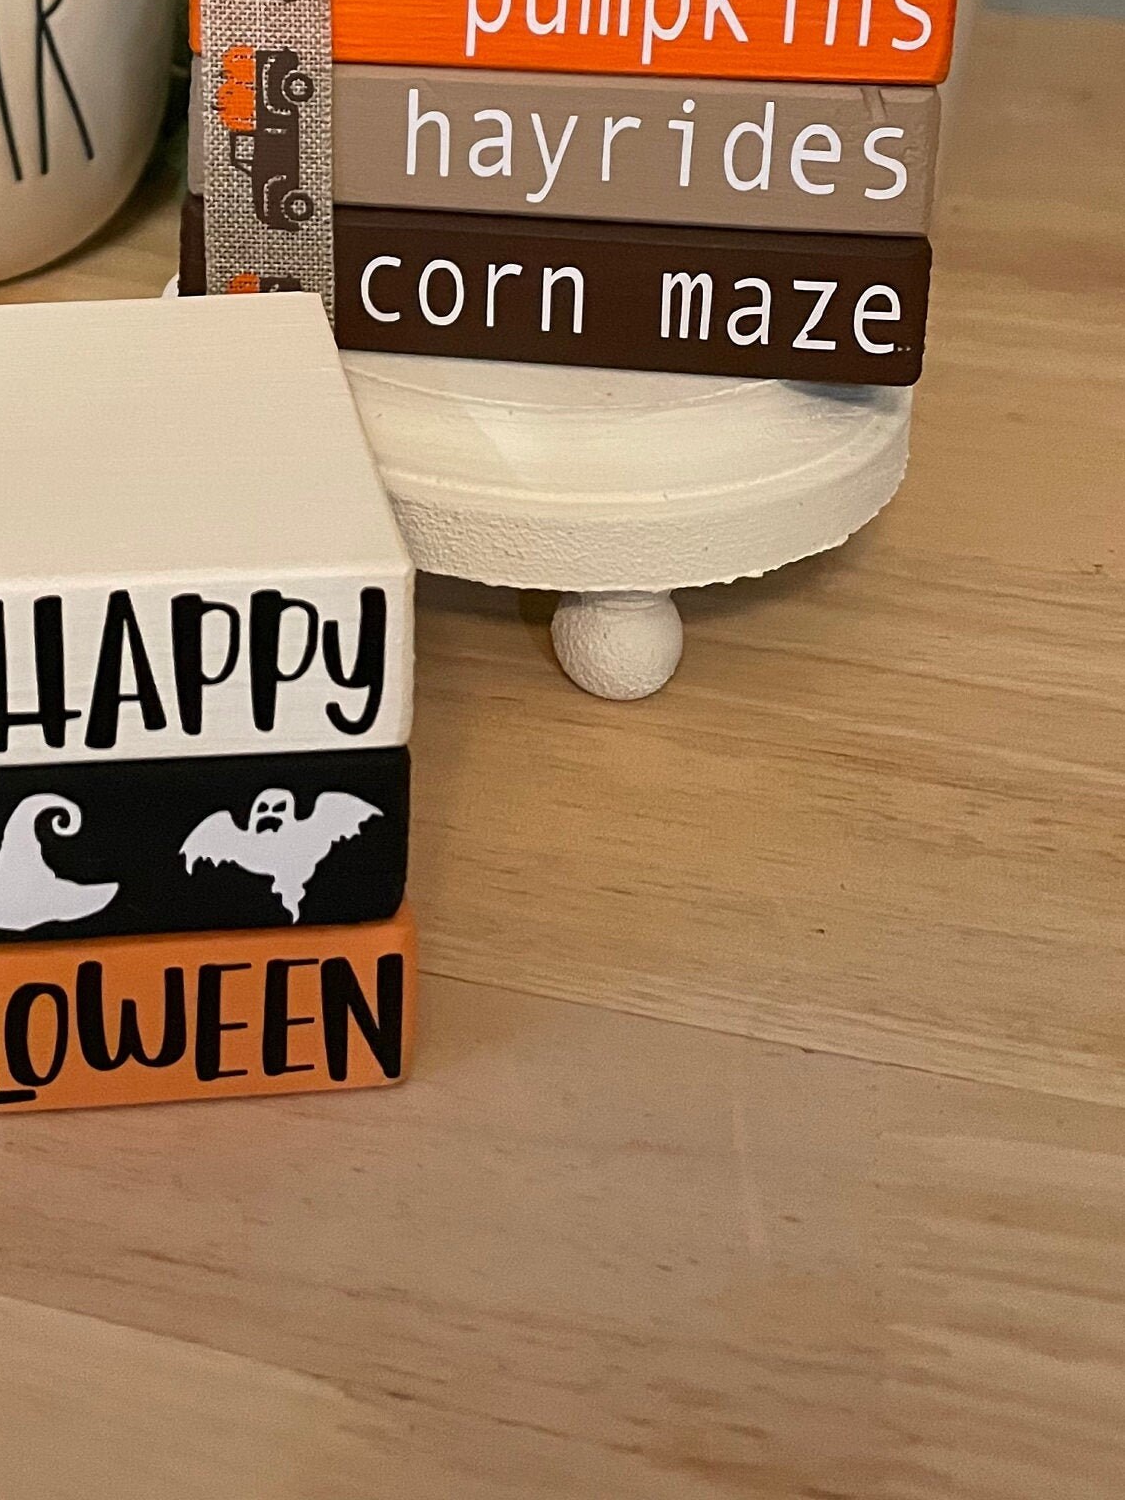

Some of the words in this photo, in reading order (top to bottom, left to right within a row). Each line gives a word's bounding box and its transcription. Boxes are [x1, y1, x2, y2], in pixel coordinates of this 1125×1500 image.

[405, 89, 910, 204] hayrides
[359, 255, 585, 335] corn
[660, 269, 906, 356] maze
